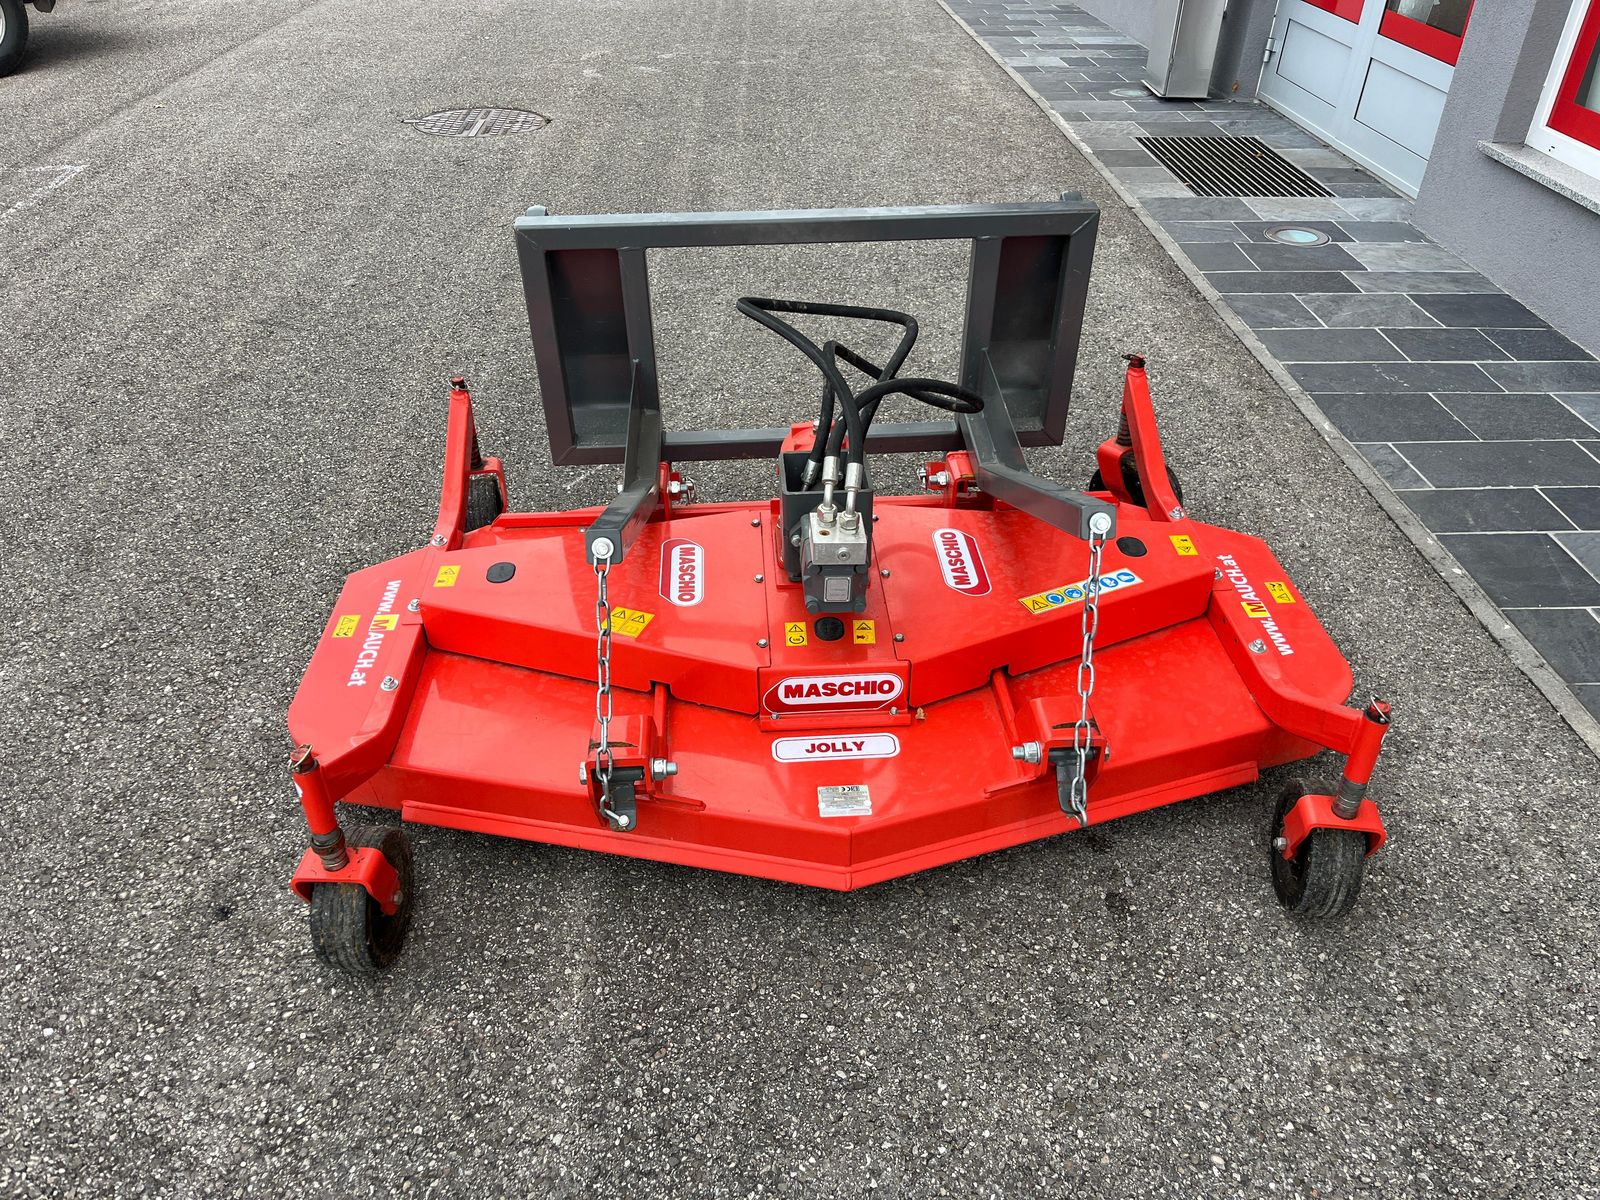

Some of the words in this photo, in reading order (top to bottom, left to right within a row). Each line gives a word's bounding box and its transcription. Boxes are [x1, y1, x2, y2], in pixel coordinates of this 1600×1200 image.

[678, 546, 696, 602] MASCHIO
[939, 531, 972, 586] MASCHIO
[1216, 554, 1294, 656] www.MAUCH.at
[346, 579, 402, 687] www.MAUCH.at
[784, 680, 895, 699] MASCHIO
[805, 741, 865, 753] JOLLY
